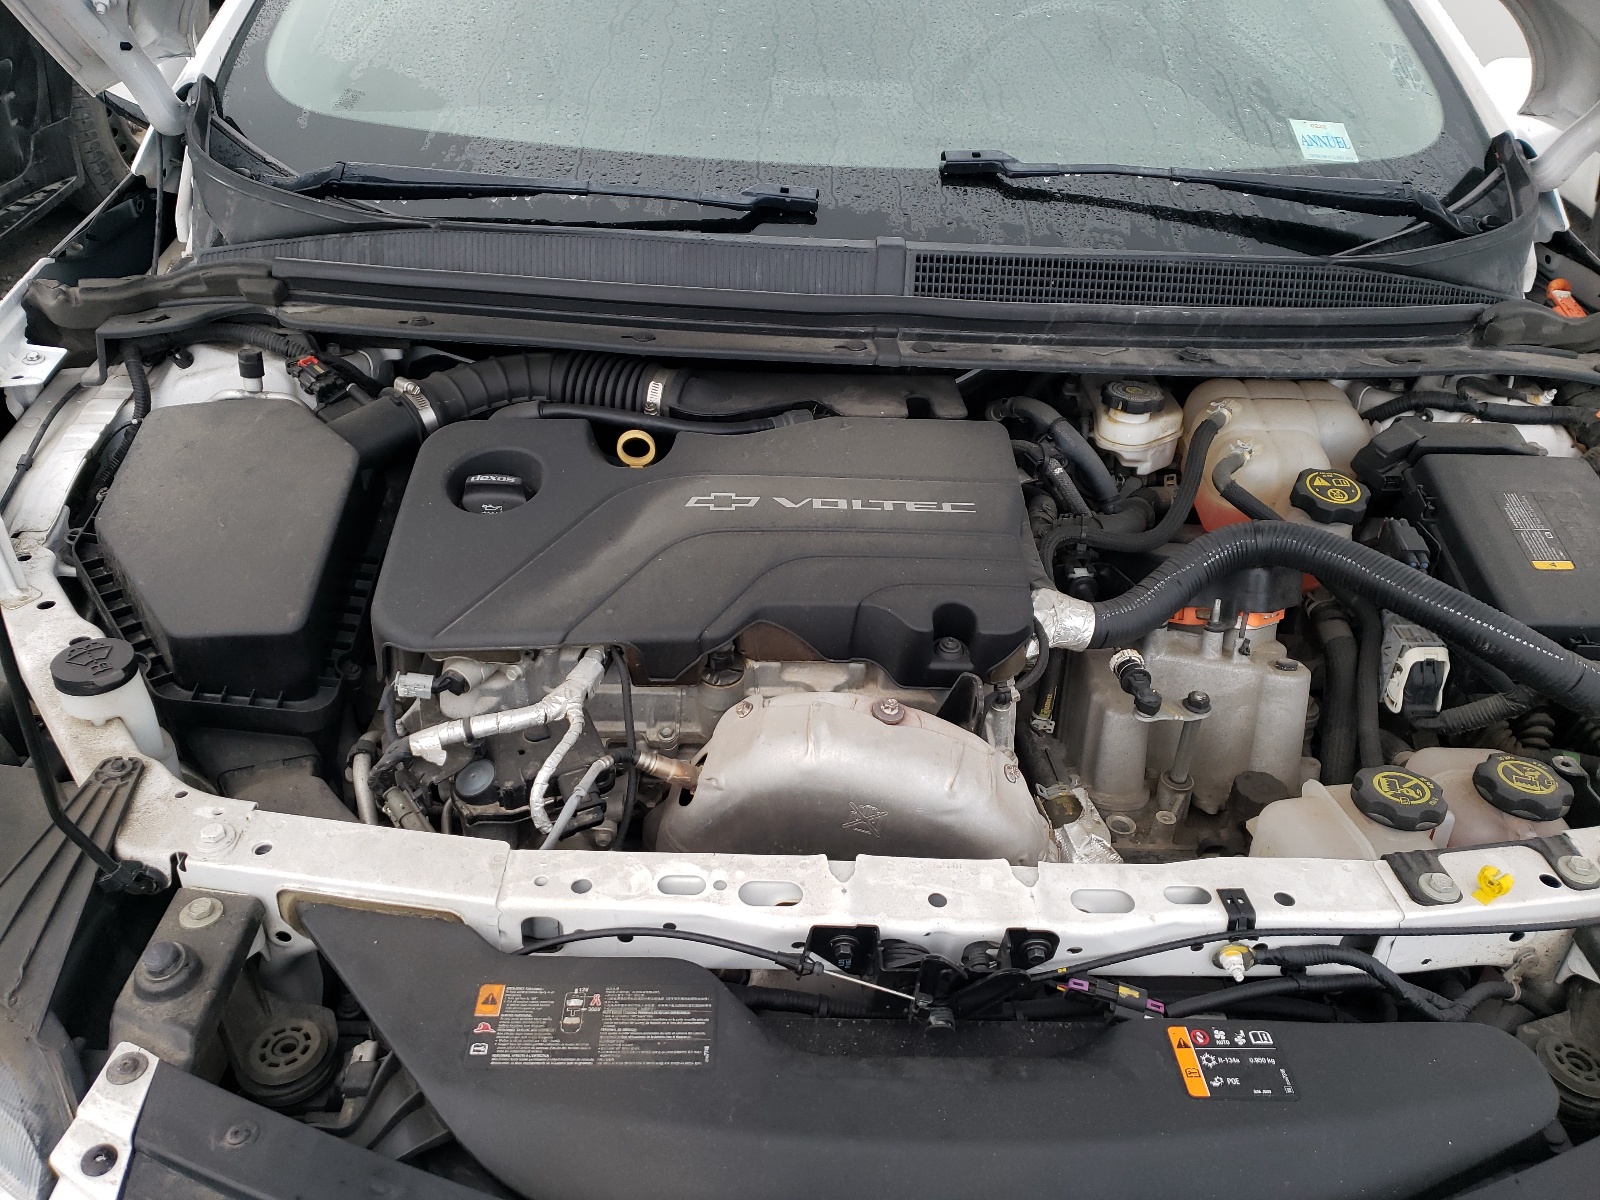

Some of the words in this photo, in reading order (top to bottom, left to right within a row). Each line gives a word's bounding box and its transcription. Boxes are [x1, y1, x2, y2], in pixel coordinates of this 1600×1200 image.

[1302, 134, 1351, 149] ANNUEL
[470, 474, 517, 483] dexos
[772, 496, 977, 513] VOLTEC
[1226, 1077, 1241, 1085] POE
